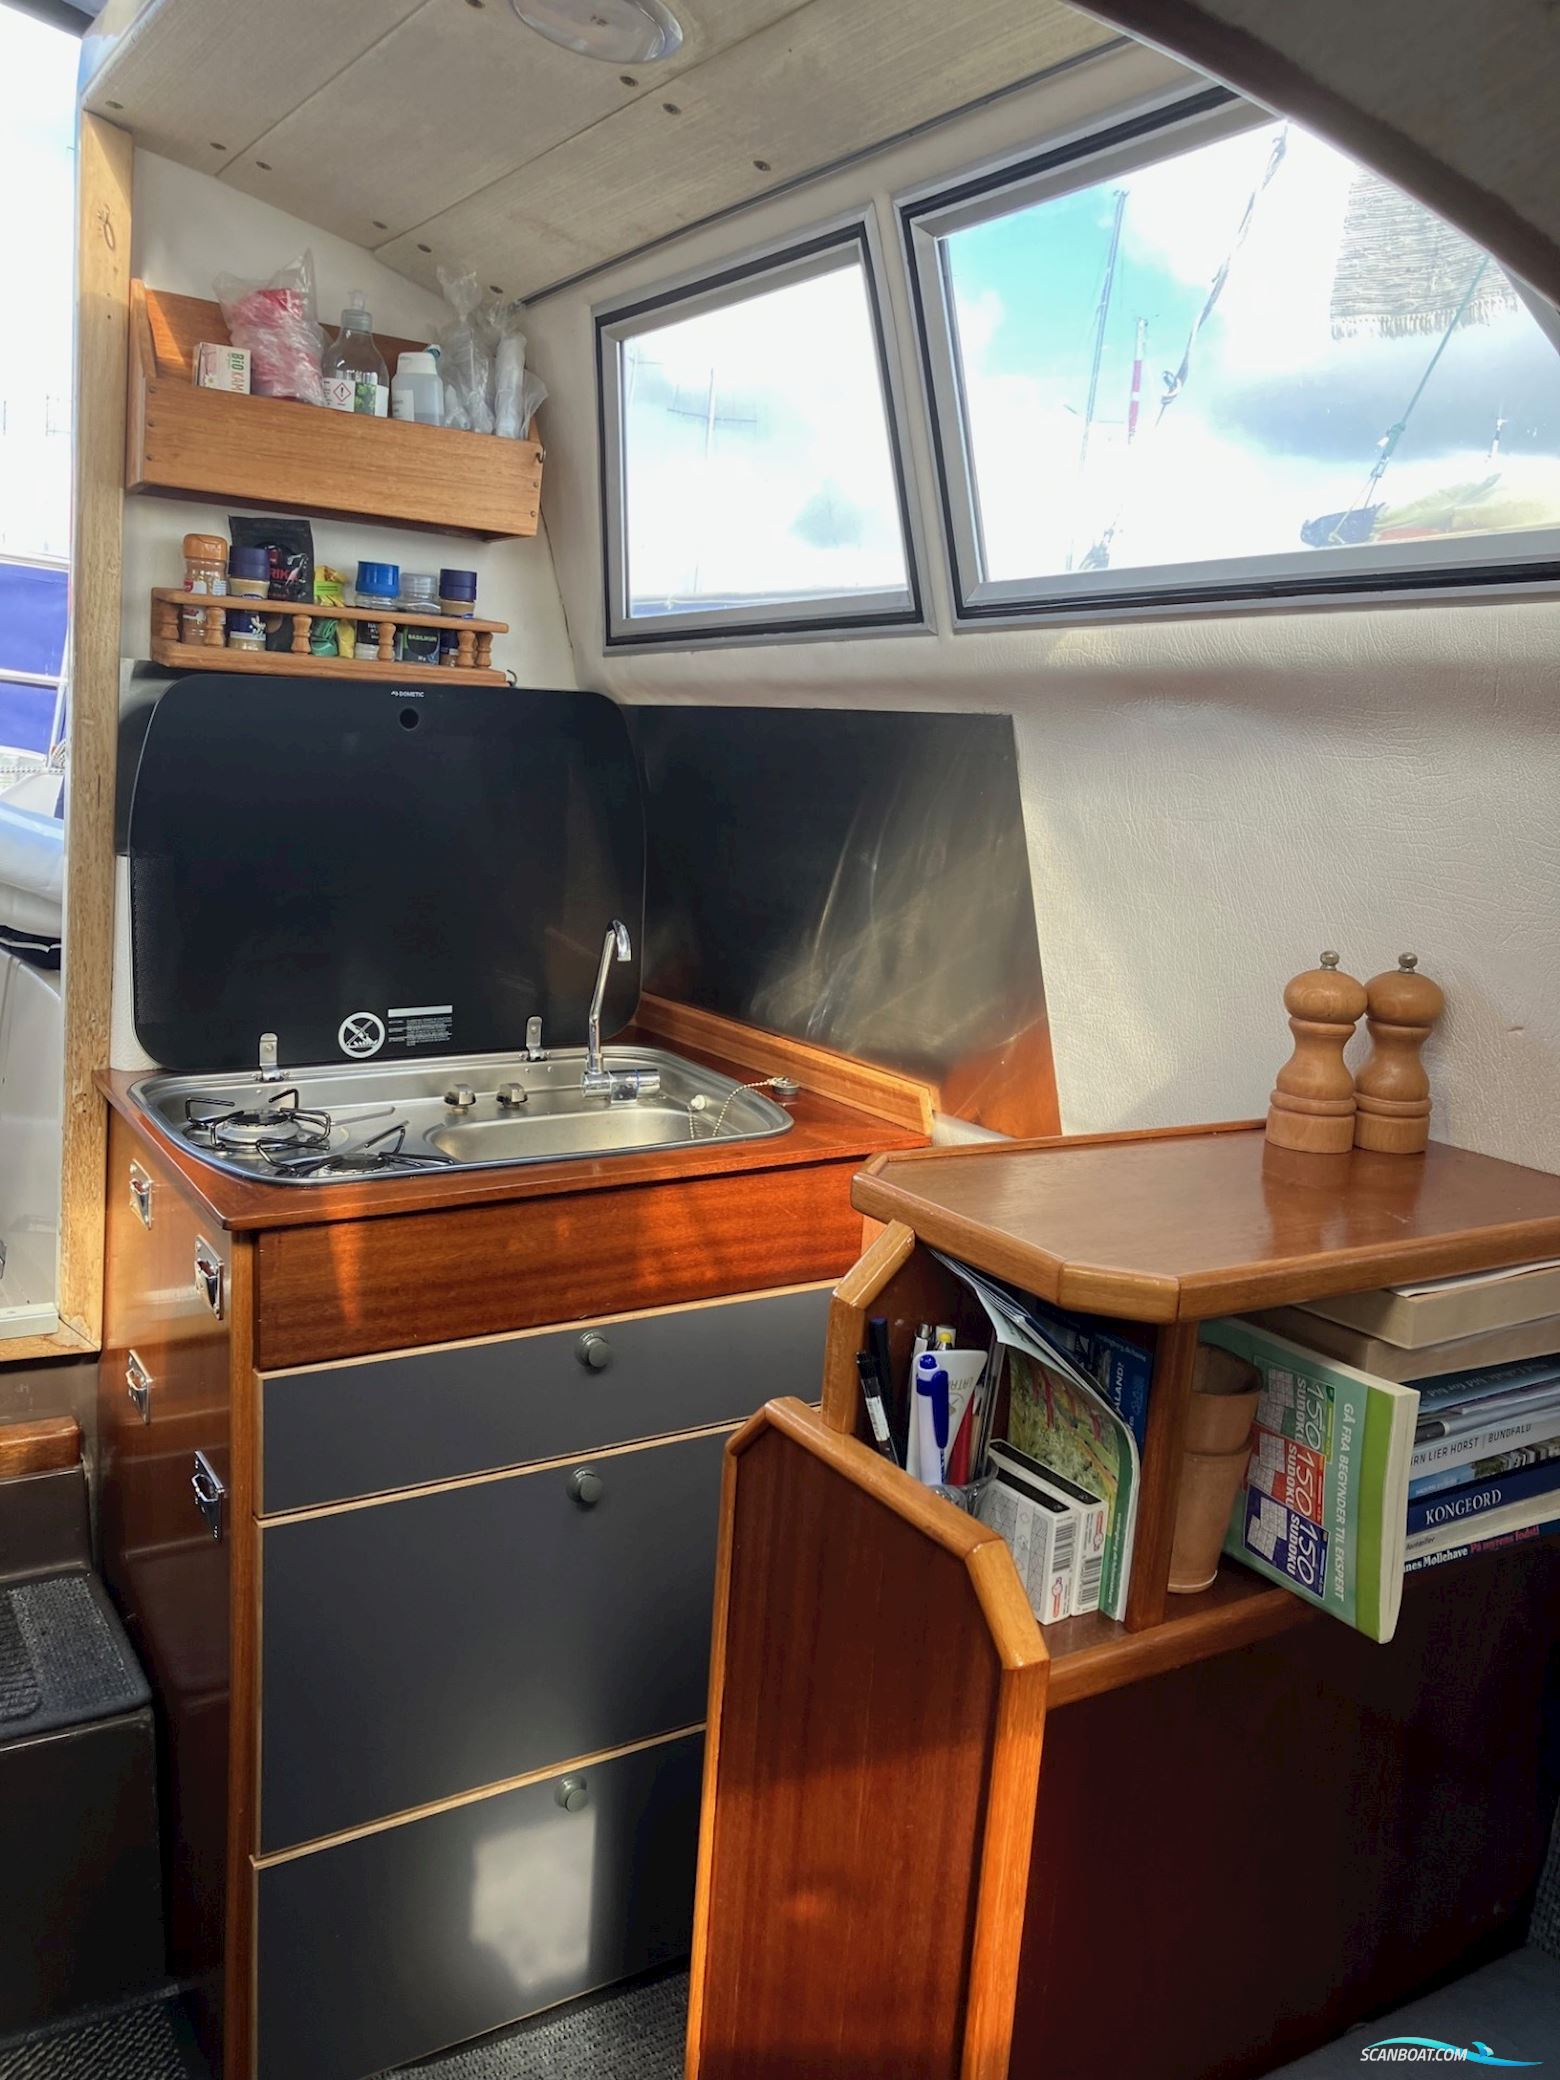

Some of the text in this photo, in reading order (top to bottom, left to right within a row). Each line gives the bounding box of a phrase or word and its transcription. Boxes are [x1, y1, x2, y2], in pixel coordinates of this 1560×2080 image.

[399, 690, 424, 698] DOMETIC
[1304, 1382, 1325, 1452] 150
[1428, 1446, 1448, 1462] LIER
[1450, 1437, 1479, 1455] HORST
[1295, 1450, 1317, 1517] 150
[1333, 1403, 1355, 1601] GÅ FRA BEGYNDER TIL EKSPERT
[1425, 1488, 1502, 1526] KONGEORD
[1286, 1513, 1300, 1577] SUDOKU
[1296, 1523, 1318, 1586] 150
